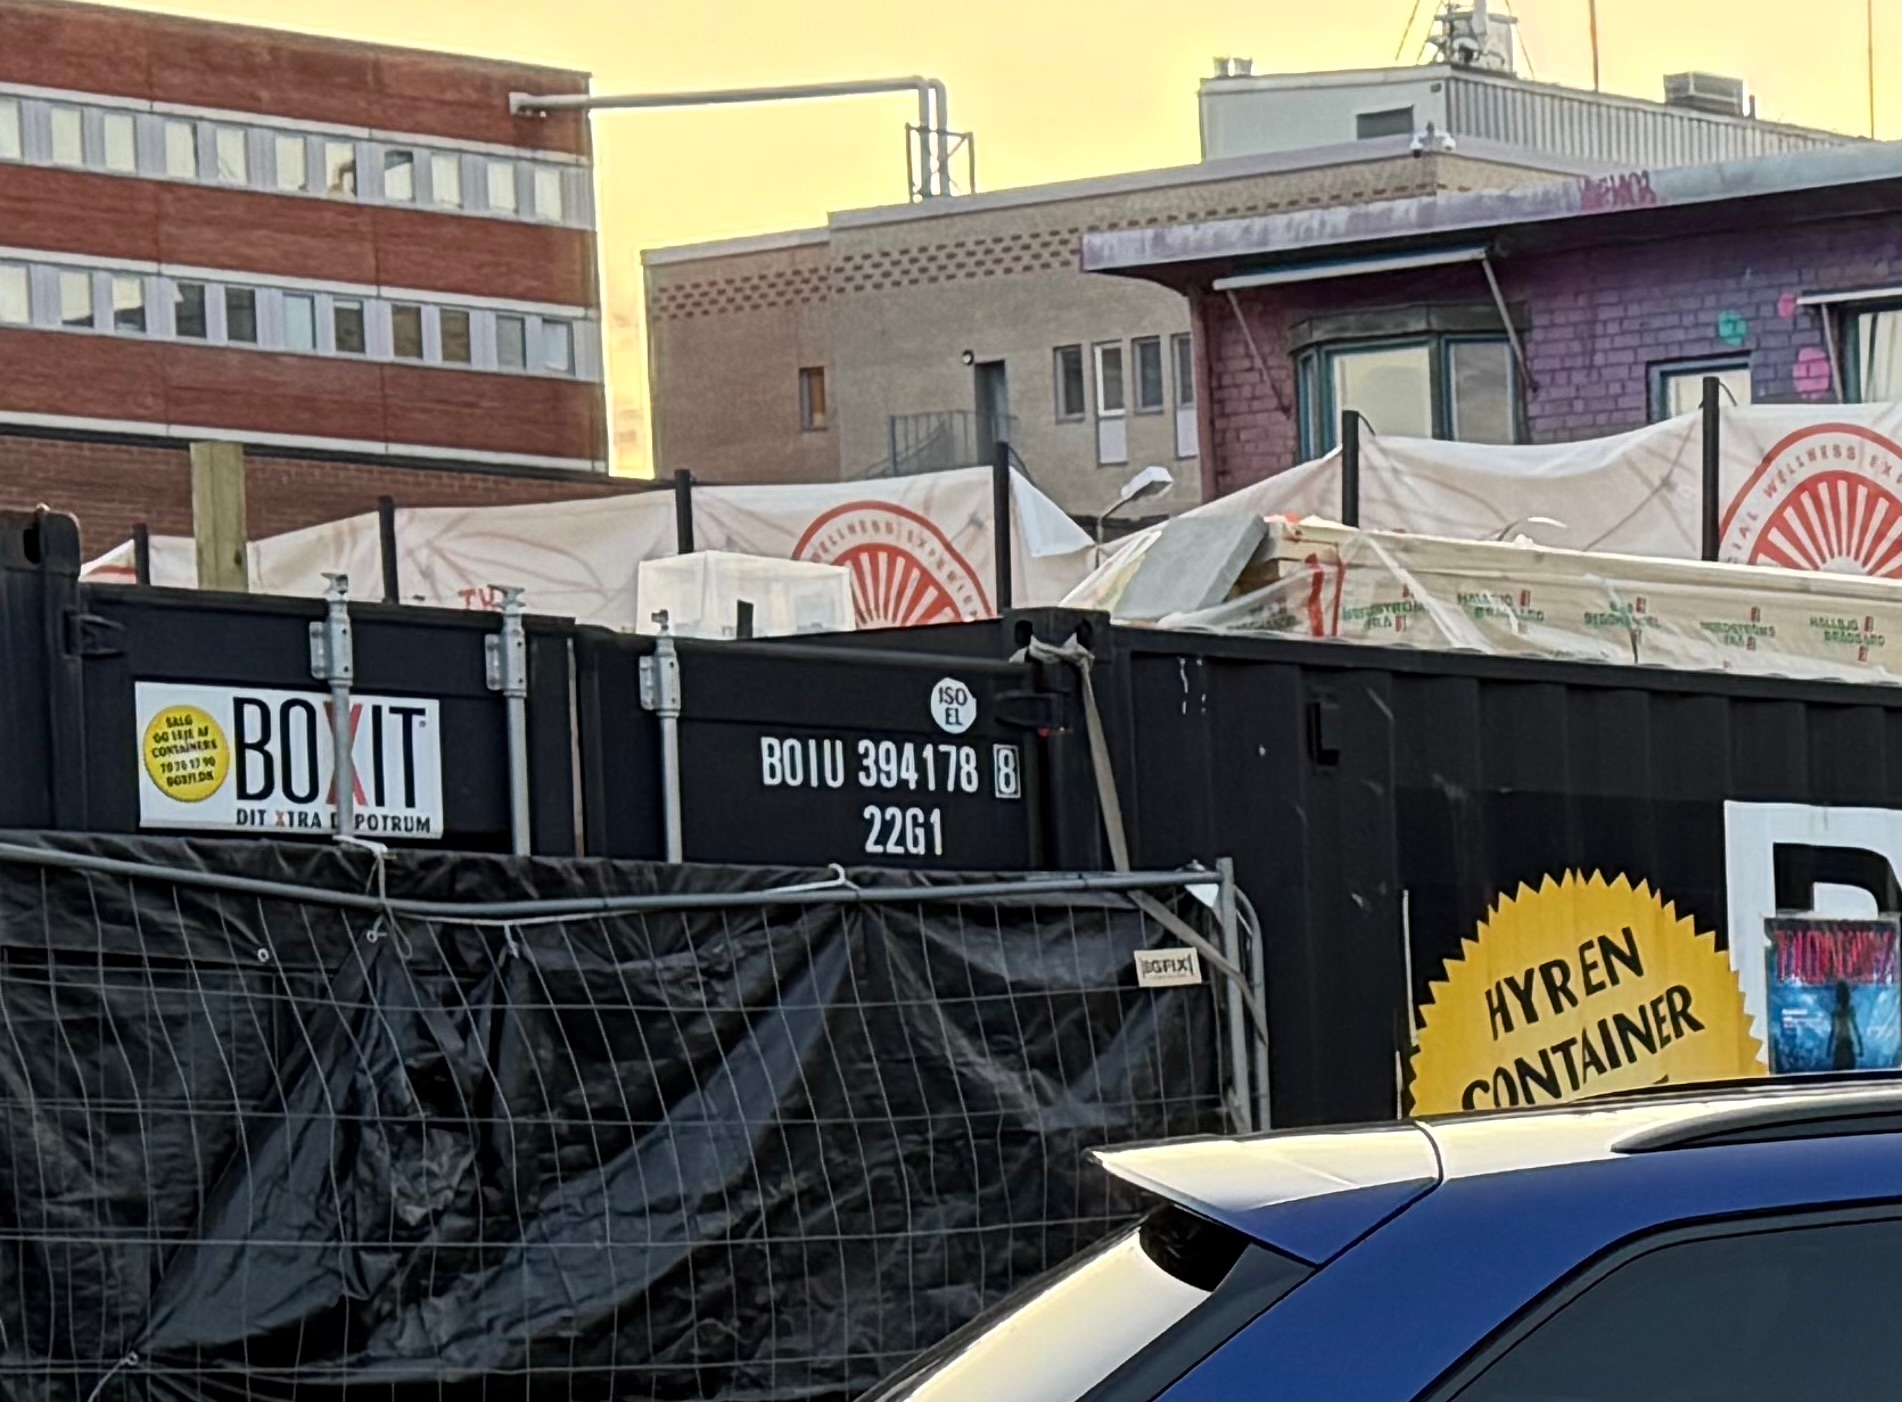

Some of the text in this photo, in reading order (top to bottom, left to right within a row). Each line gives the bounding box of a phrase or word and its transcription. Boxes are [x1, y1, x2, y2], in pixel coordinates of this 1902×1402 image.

[1763, 443, 1857, 499] WELLNESS
[938, 685, 969, 707] ISO
[944, 707, 963, 727] EL
[760, 736, 845, 789] BOIU
[857, 738, 979, 793] 394178
[236, 808, 431, 834] DIT XTRA DPOTRUM
[863, 804, 943, 856] 22G1
[1484, 926, 1645, 1042] HYREN
[1461, 983, 1706, 1111] CONTAINER
